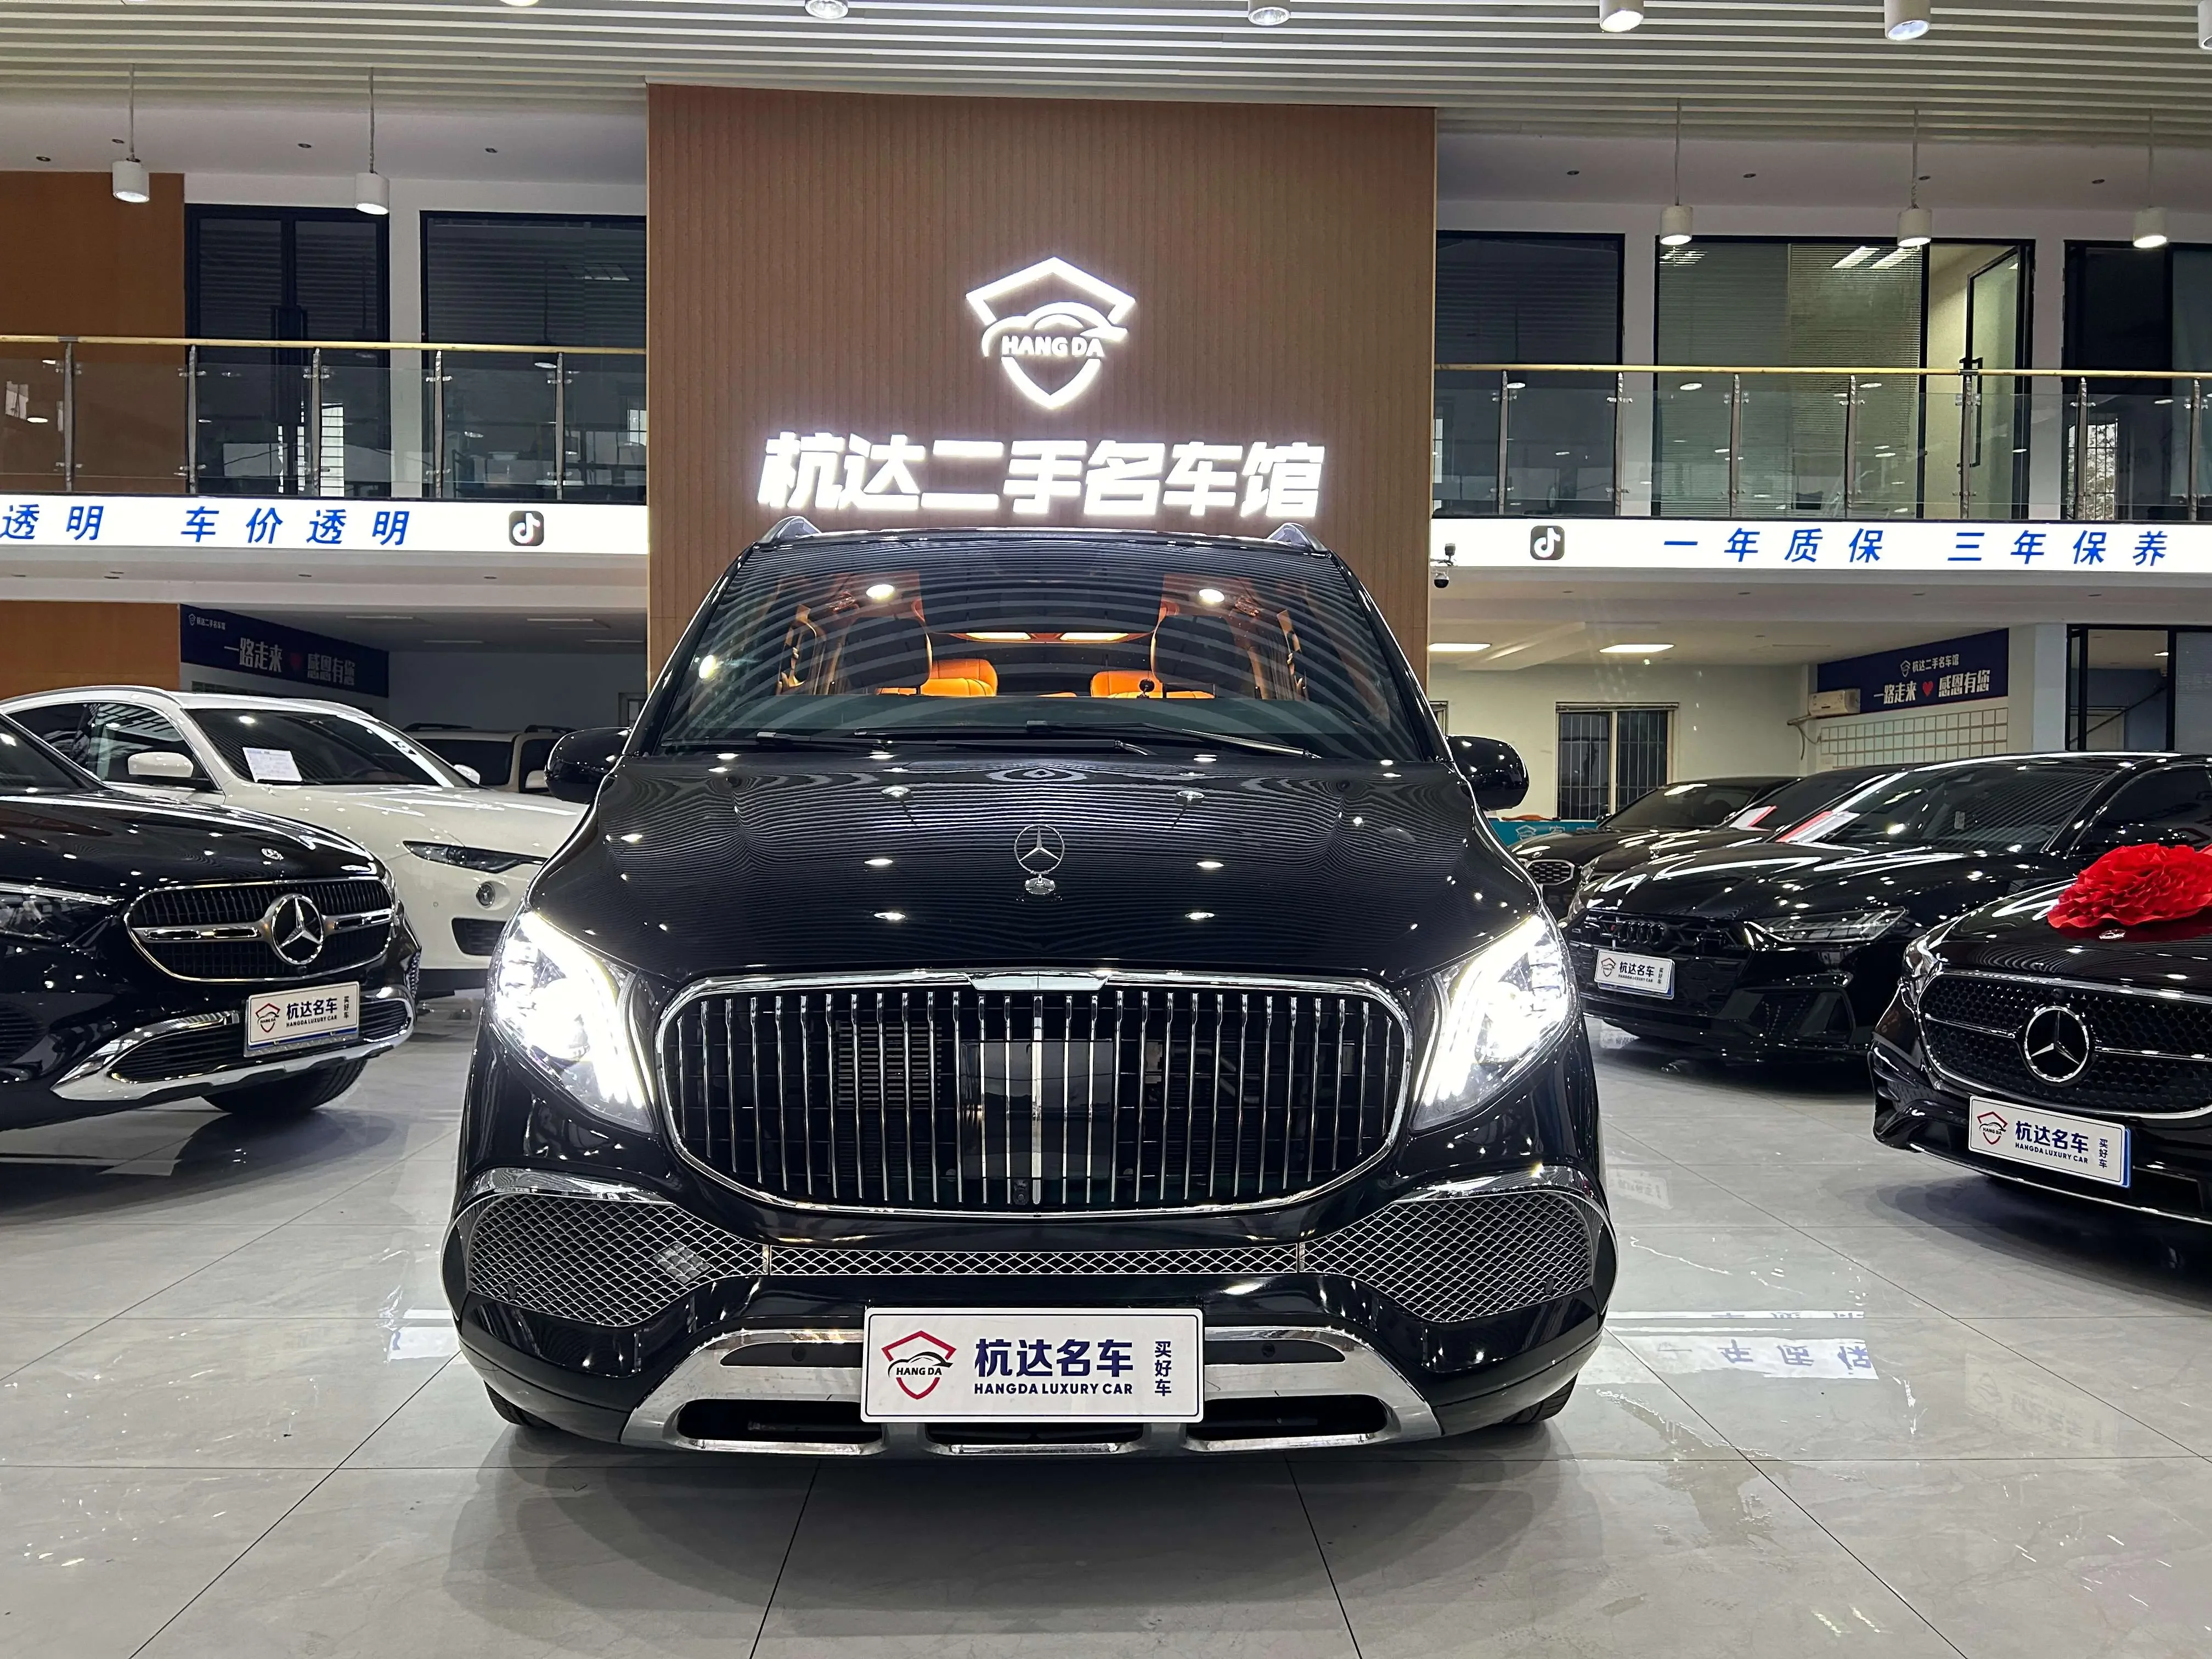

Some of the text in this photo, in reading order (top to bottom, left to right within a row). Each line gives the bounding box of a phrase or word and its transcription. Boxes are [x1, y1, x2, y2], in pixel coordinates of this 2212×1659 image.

[1001, 335, 1106, 358] HANG DA
[758, 431, 1325, 518] 杭达二手名车馆
[0, 504, 409, 544] 透明 车价透明
[1663, 528, 2168, 566] 一年质保 三年保养
[224, 637, 283, 673] 一路走来
[1912, 654, 1959, 673] 杭达二手名车馆
[1874, 669, 1990, 704] 一路走来 感恩有您
[1620, 961, 1655, 977] 杭达名车
[286, 998, 337, 1020] 杭达名车
[2015, 1120, 2089, 1153] 杭达名车
[2015, 1142, 2089, 1164] HANGDA LUXURY CAR
[2099, 1137, 2108, 1169] 买好车
[896, 1367, 943, 1376] HANG DA
[974, 1338, 1134, 1378] 杭达名车
[1154, 1341, 1172, 1397] 买好车
[974, 1383, 1133, 1395] HANGDA LUXURY CAR
